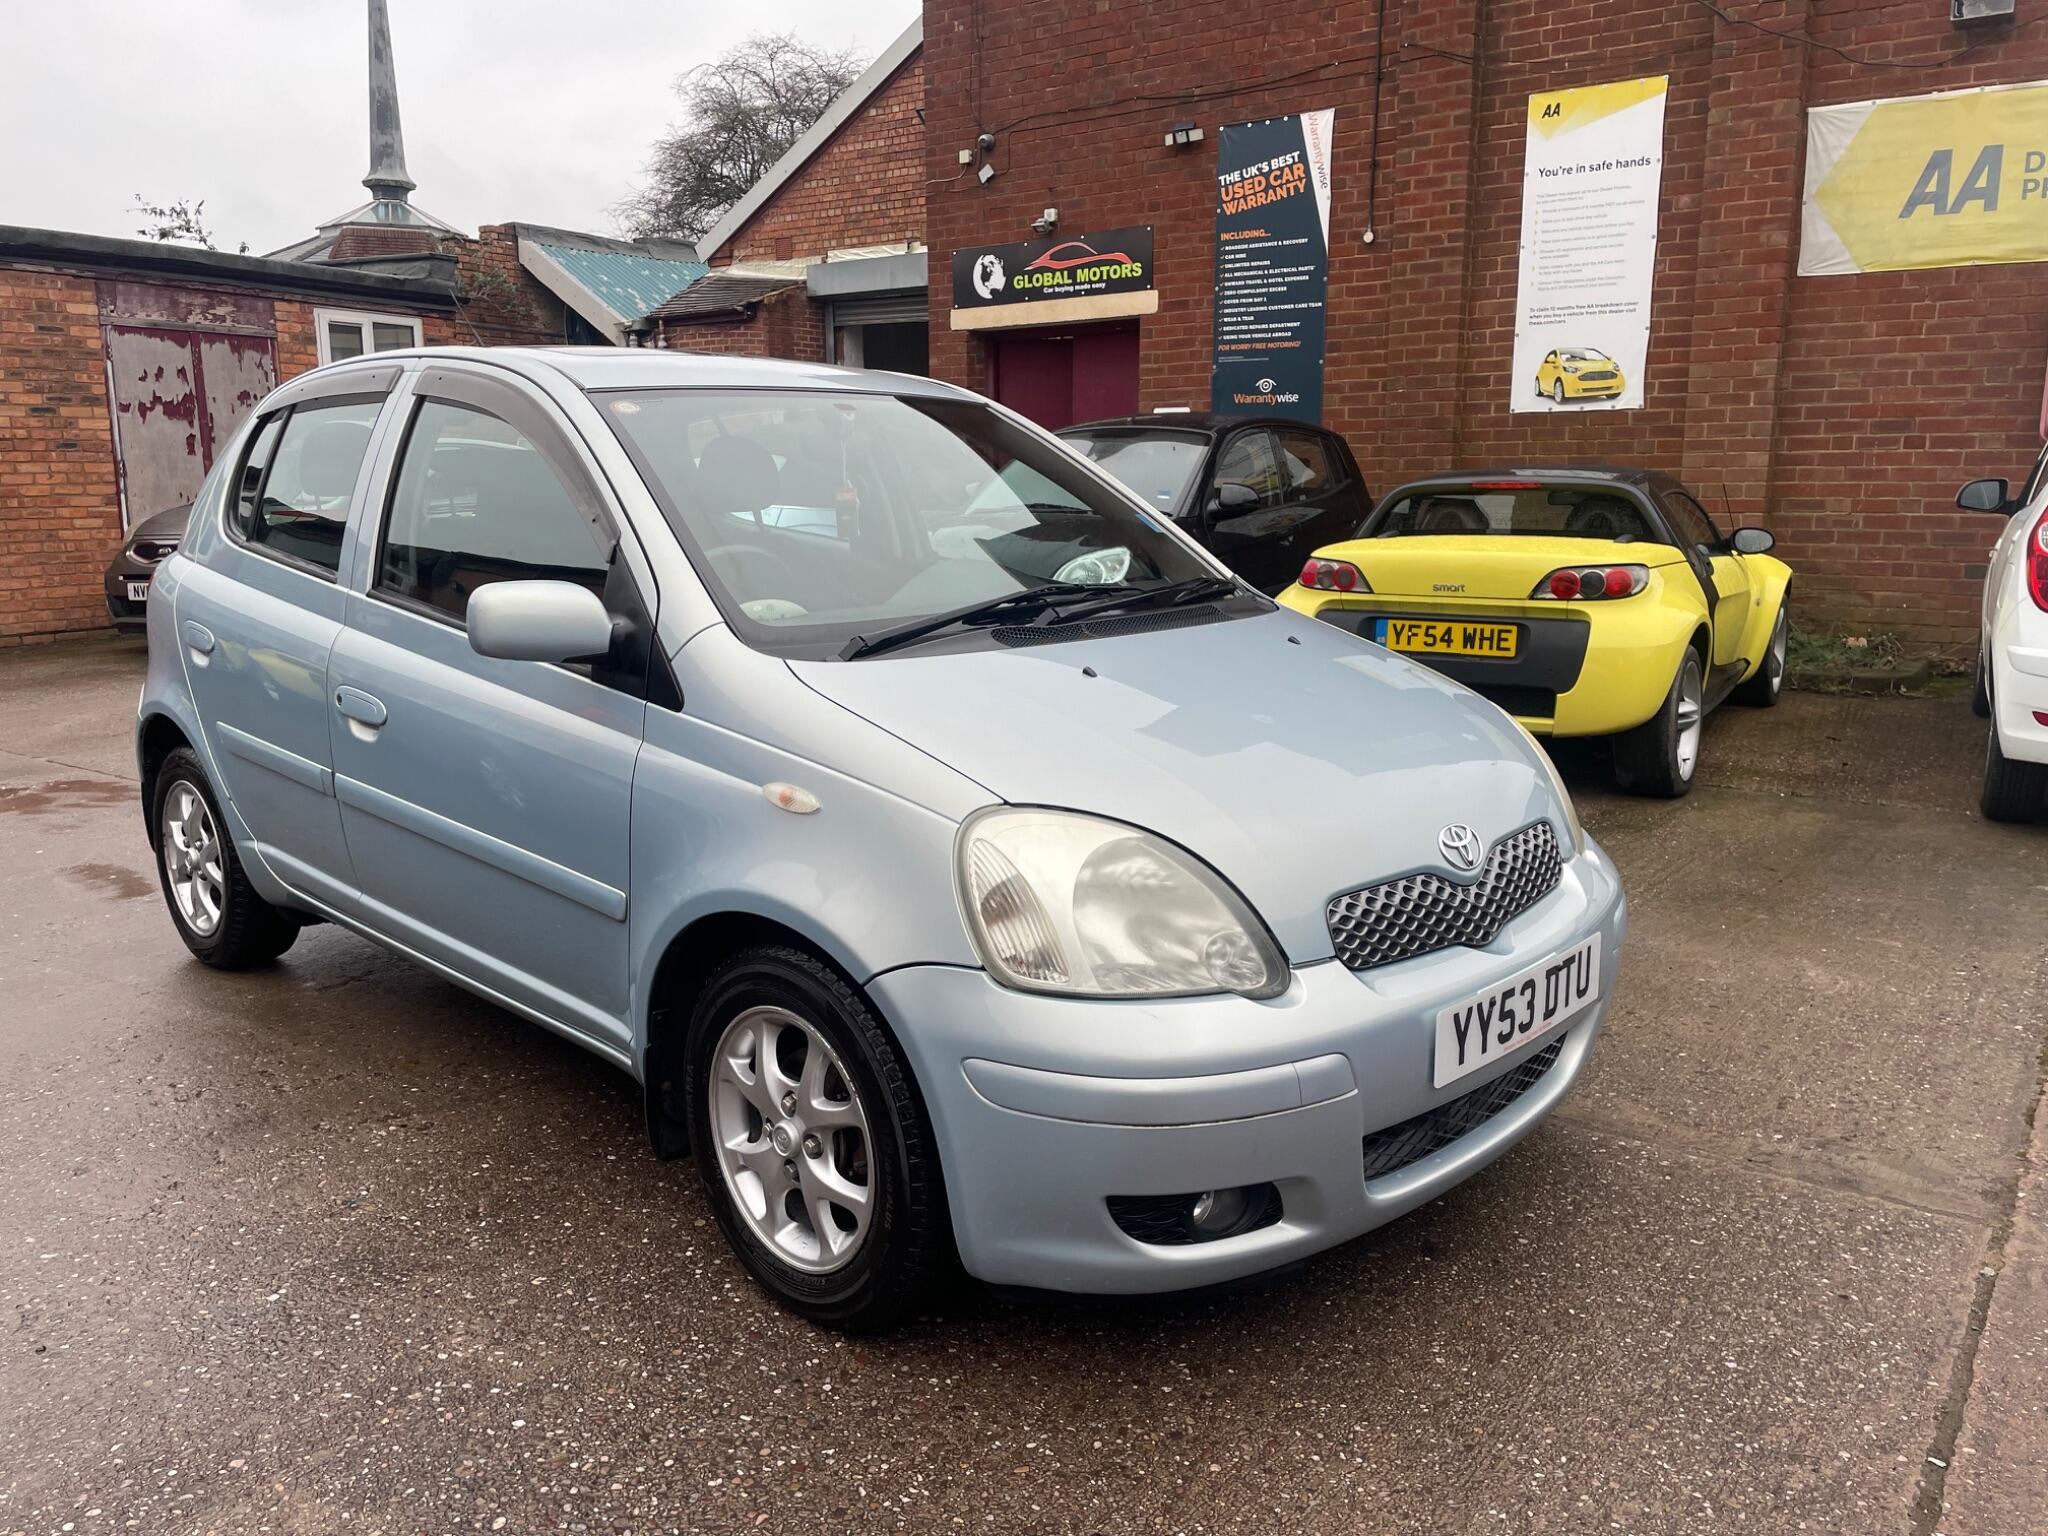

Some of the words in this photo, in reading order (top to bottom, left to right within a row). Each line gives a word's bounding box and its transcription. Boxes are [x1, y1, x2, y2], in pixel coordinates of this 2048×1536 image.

[1541, 102, 1561, 119] AA
[1218, 170, 1242, 186] THE
[1242, 162, 1270, 178] UK'S
[1270, 150, 1300, 170] BEST
[1538, 164, 1573, 178] You're
[1576, 164, 1586, 174] in
[1588, 160, 1613, 172] safe
[1615, 156, 1652, 170] hands
[1220, 176, 1267, 202] USED
[1270, 162, 1306, 186] CAR
[1898, 144, 2004, 219] AA
[1222, 178, 1306, 216] WARRANTY
[1013, 270, 1072, 289] GLOBAL
[1076, 262, 1142, 282] MOTORS
[1233, 392, 1300, 406] Warrantywise
[1432, 584, 1466, 593] smart
[1392, 623, 1453, 648] YF54
[1462, 626, 1513, 651] WHE
[1453, 978, 1536, 1066] YY53
[1542, 944, 1592, 1022] DTU
